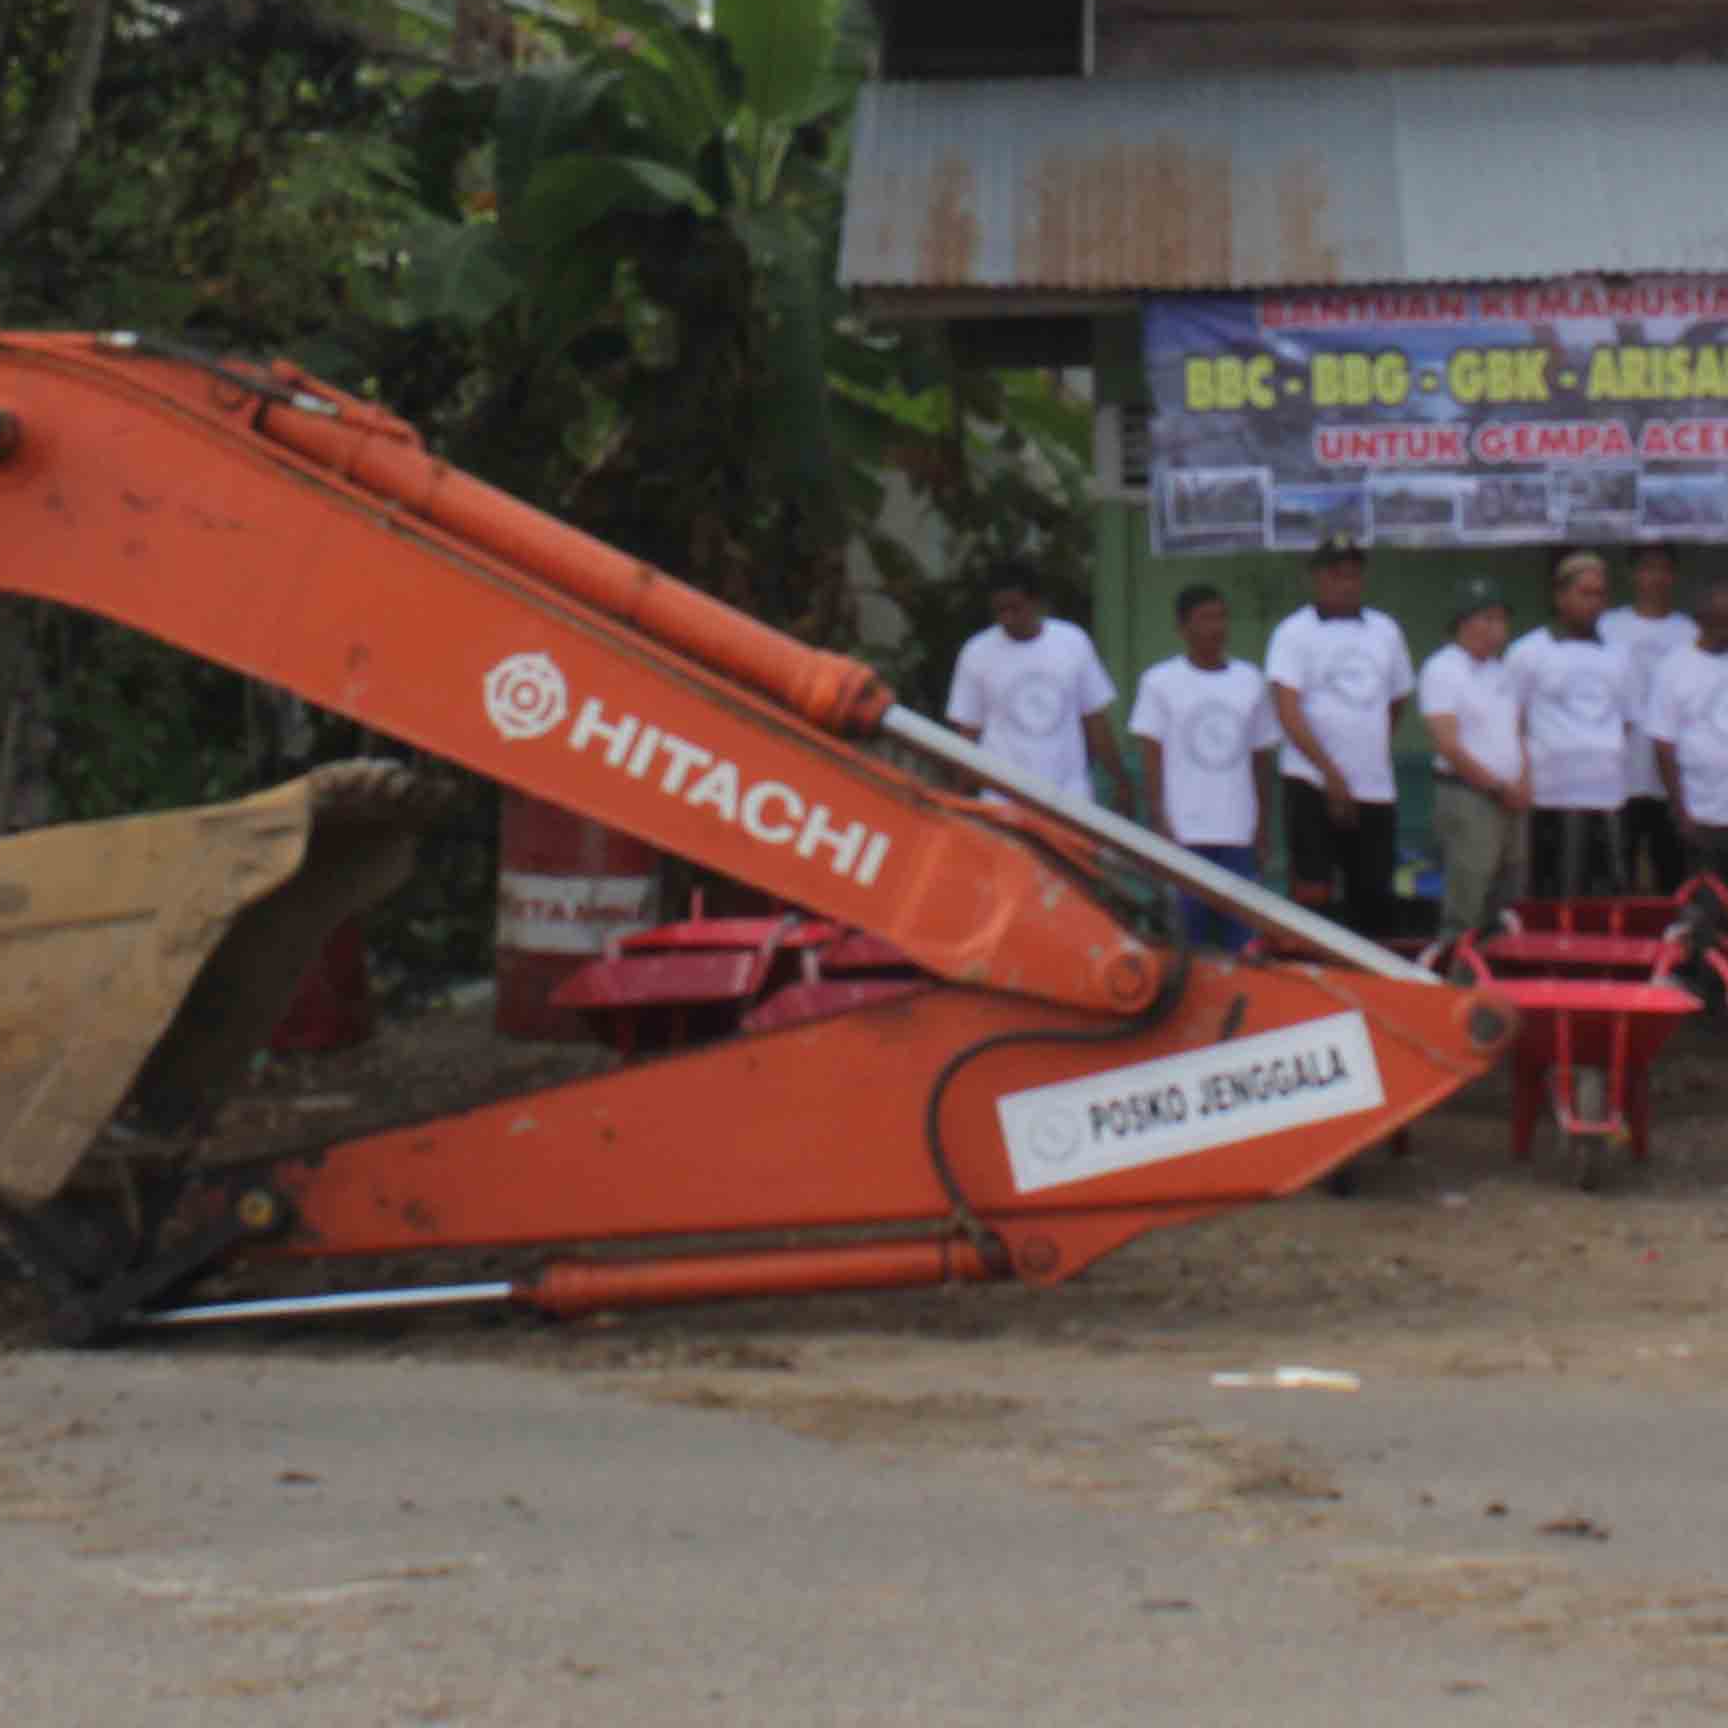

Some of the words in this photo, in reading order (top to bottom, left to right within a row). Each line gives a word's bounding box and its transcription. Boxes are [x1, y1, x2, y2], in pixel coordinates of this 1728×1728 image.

[1262, 289, 1464, 326] BANTUAN
[1185, 354, 1276, 410] BBC
[1312, 352, 1409, 406] BBG
[1448, 348, 1551, 403] GBK
[1319, 429, 1459, 460] UNTUK
[1479, 425, 1632, 457] GEMPA
[568, 696, 892, 888] HITACHI
[1088, 1083, 1187, 1141] POSKO
[1197, 1045, 1349, 1116] JENGGALA
